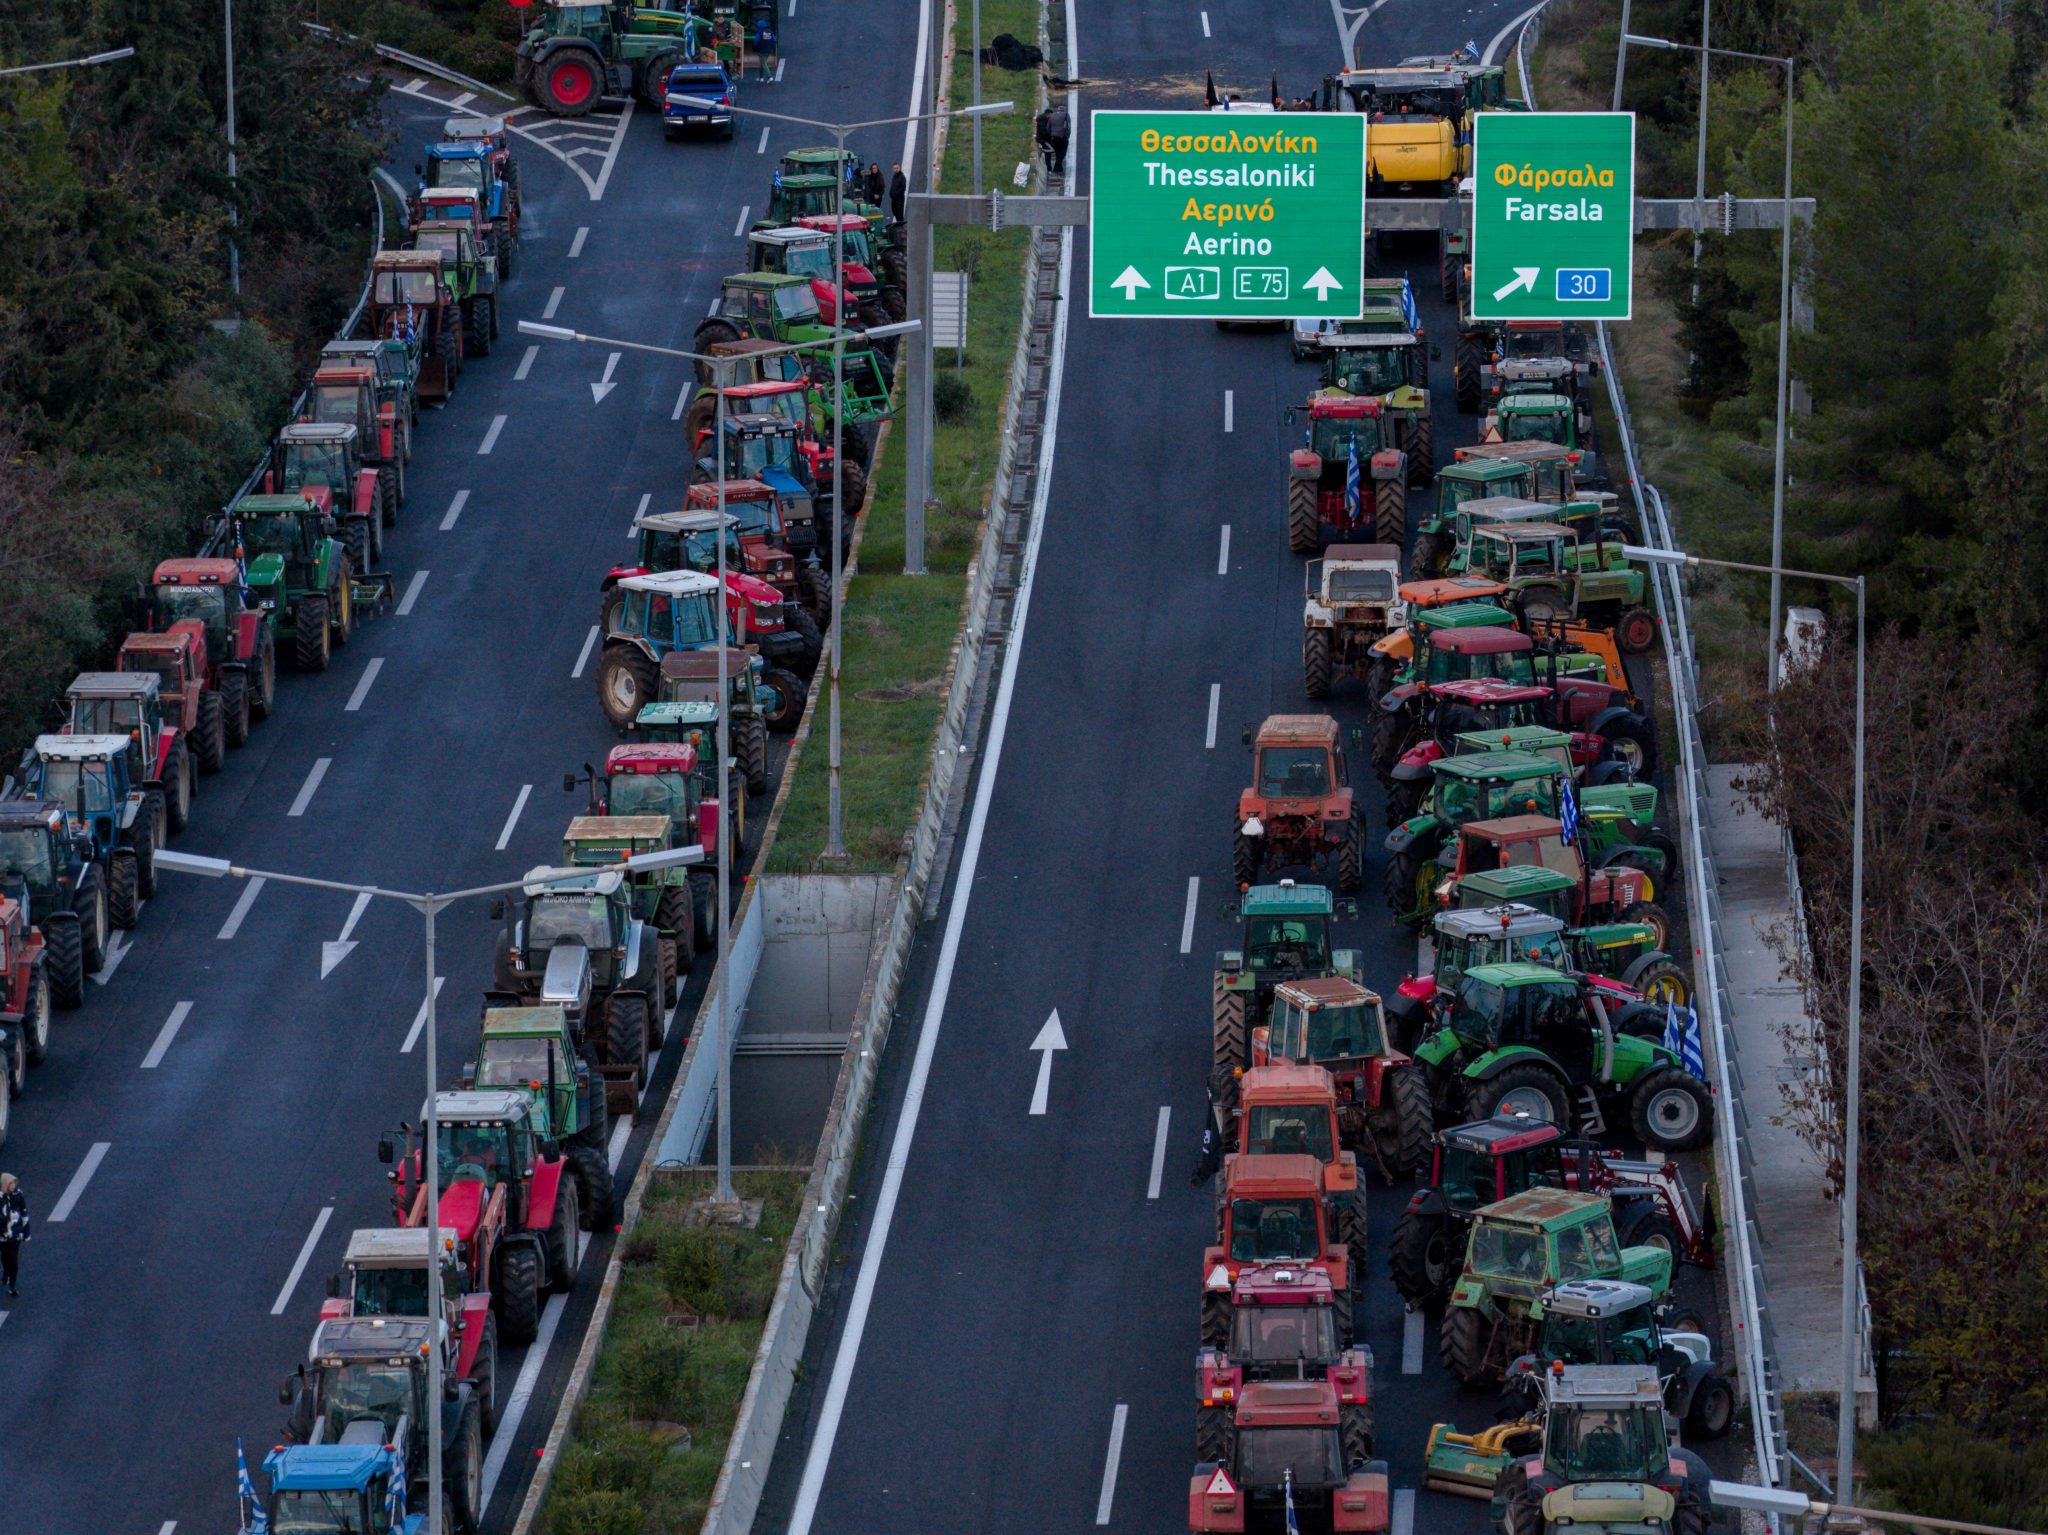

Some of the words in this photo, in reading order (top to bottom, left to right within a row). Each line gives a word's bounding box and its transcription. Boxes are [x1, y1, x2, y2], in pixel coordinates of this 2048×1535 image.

[1141, 128, 1317, 154] Θεσσαλονίκη
[1143, 162, 1315, 187] Thessaloniki
[1494, 163, 1614, 192] Φάρσαλα
[1181, 197, 1275, 227] Αερινό
[1505, 197, 1603, 221] Farsala
[1183, 231, 1272, 256] Aerino
[1180, 273, 1205, 293] A1
[1240, 273, 1252, 293] E
[1261, 273, 1283, 293] 75
[1570, 274, 1596, 295] 30
